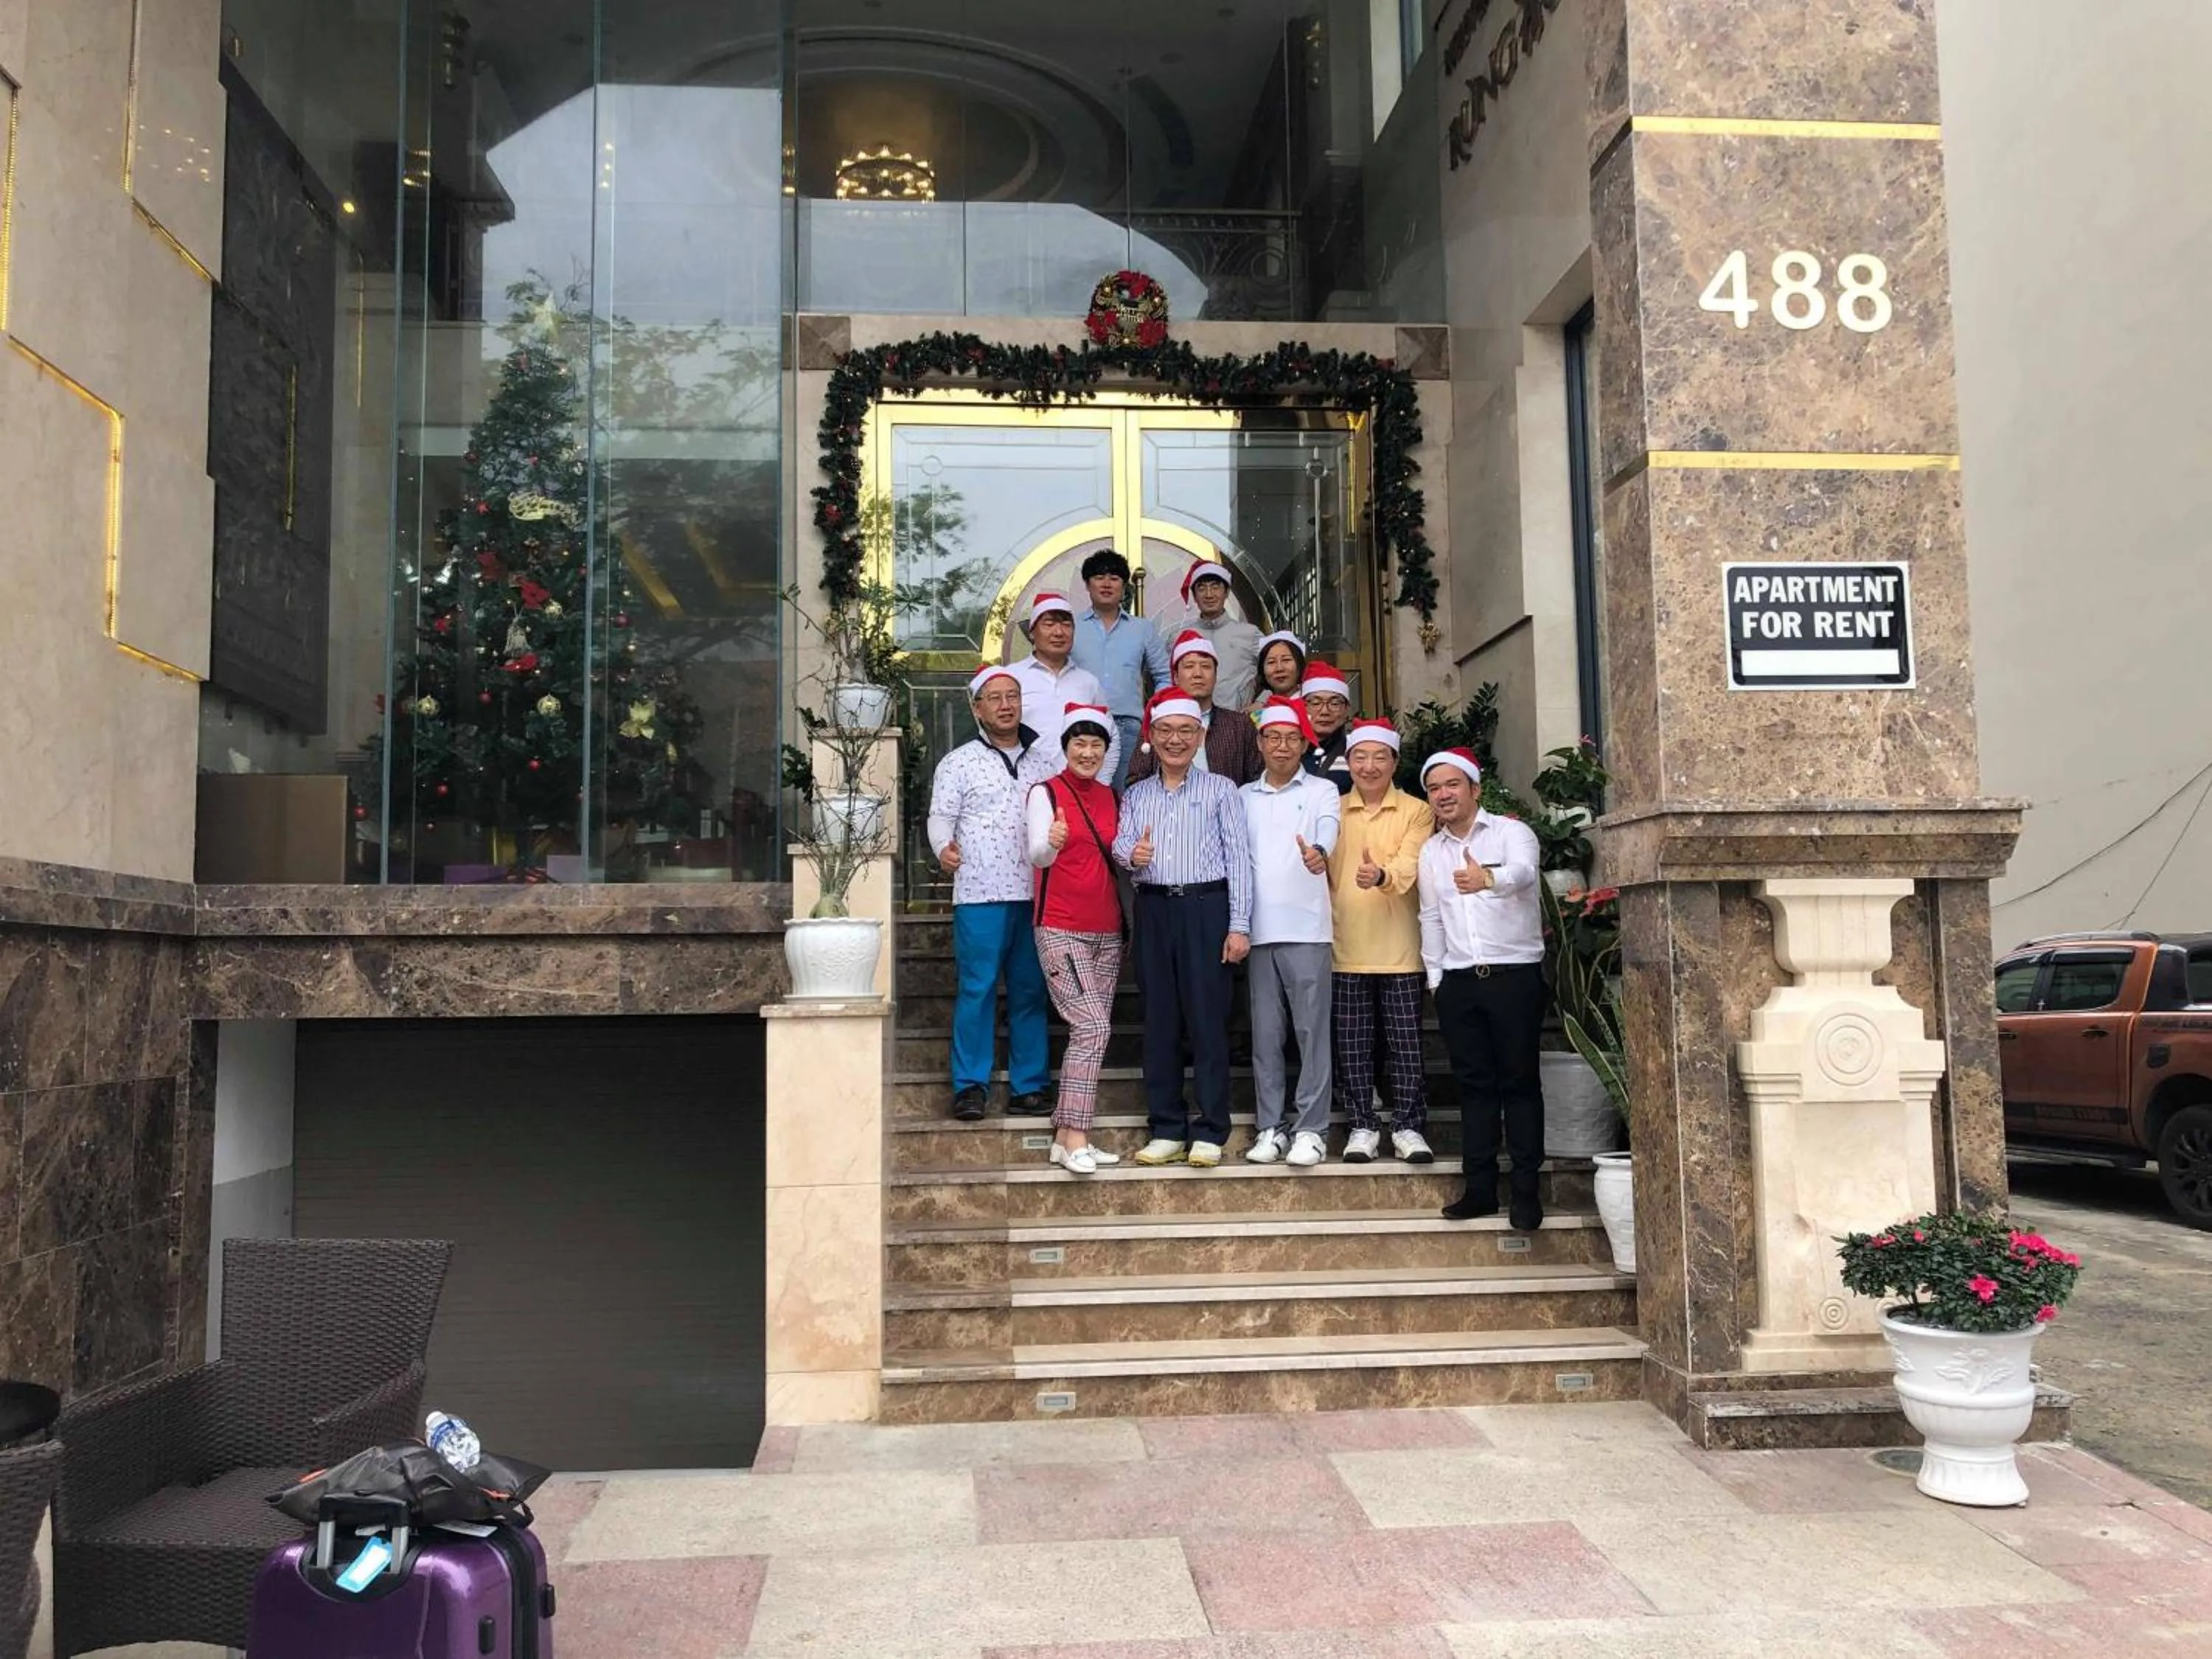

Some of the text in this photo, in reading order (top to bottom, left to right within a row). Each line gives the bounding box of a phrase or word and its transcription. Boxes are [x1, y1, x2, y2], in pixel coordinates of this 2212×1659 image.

[1699, 250, 1892, 332] 488
[1733, 576, 1899, 603] APARTMENT
[1742, 611, 1894, 639] FOR RENT
